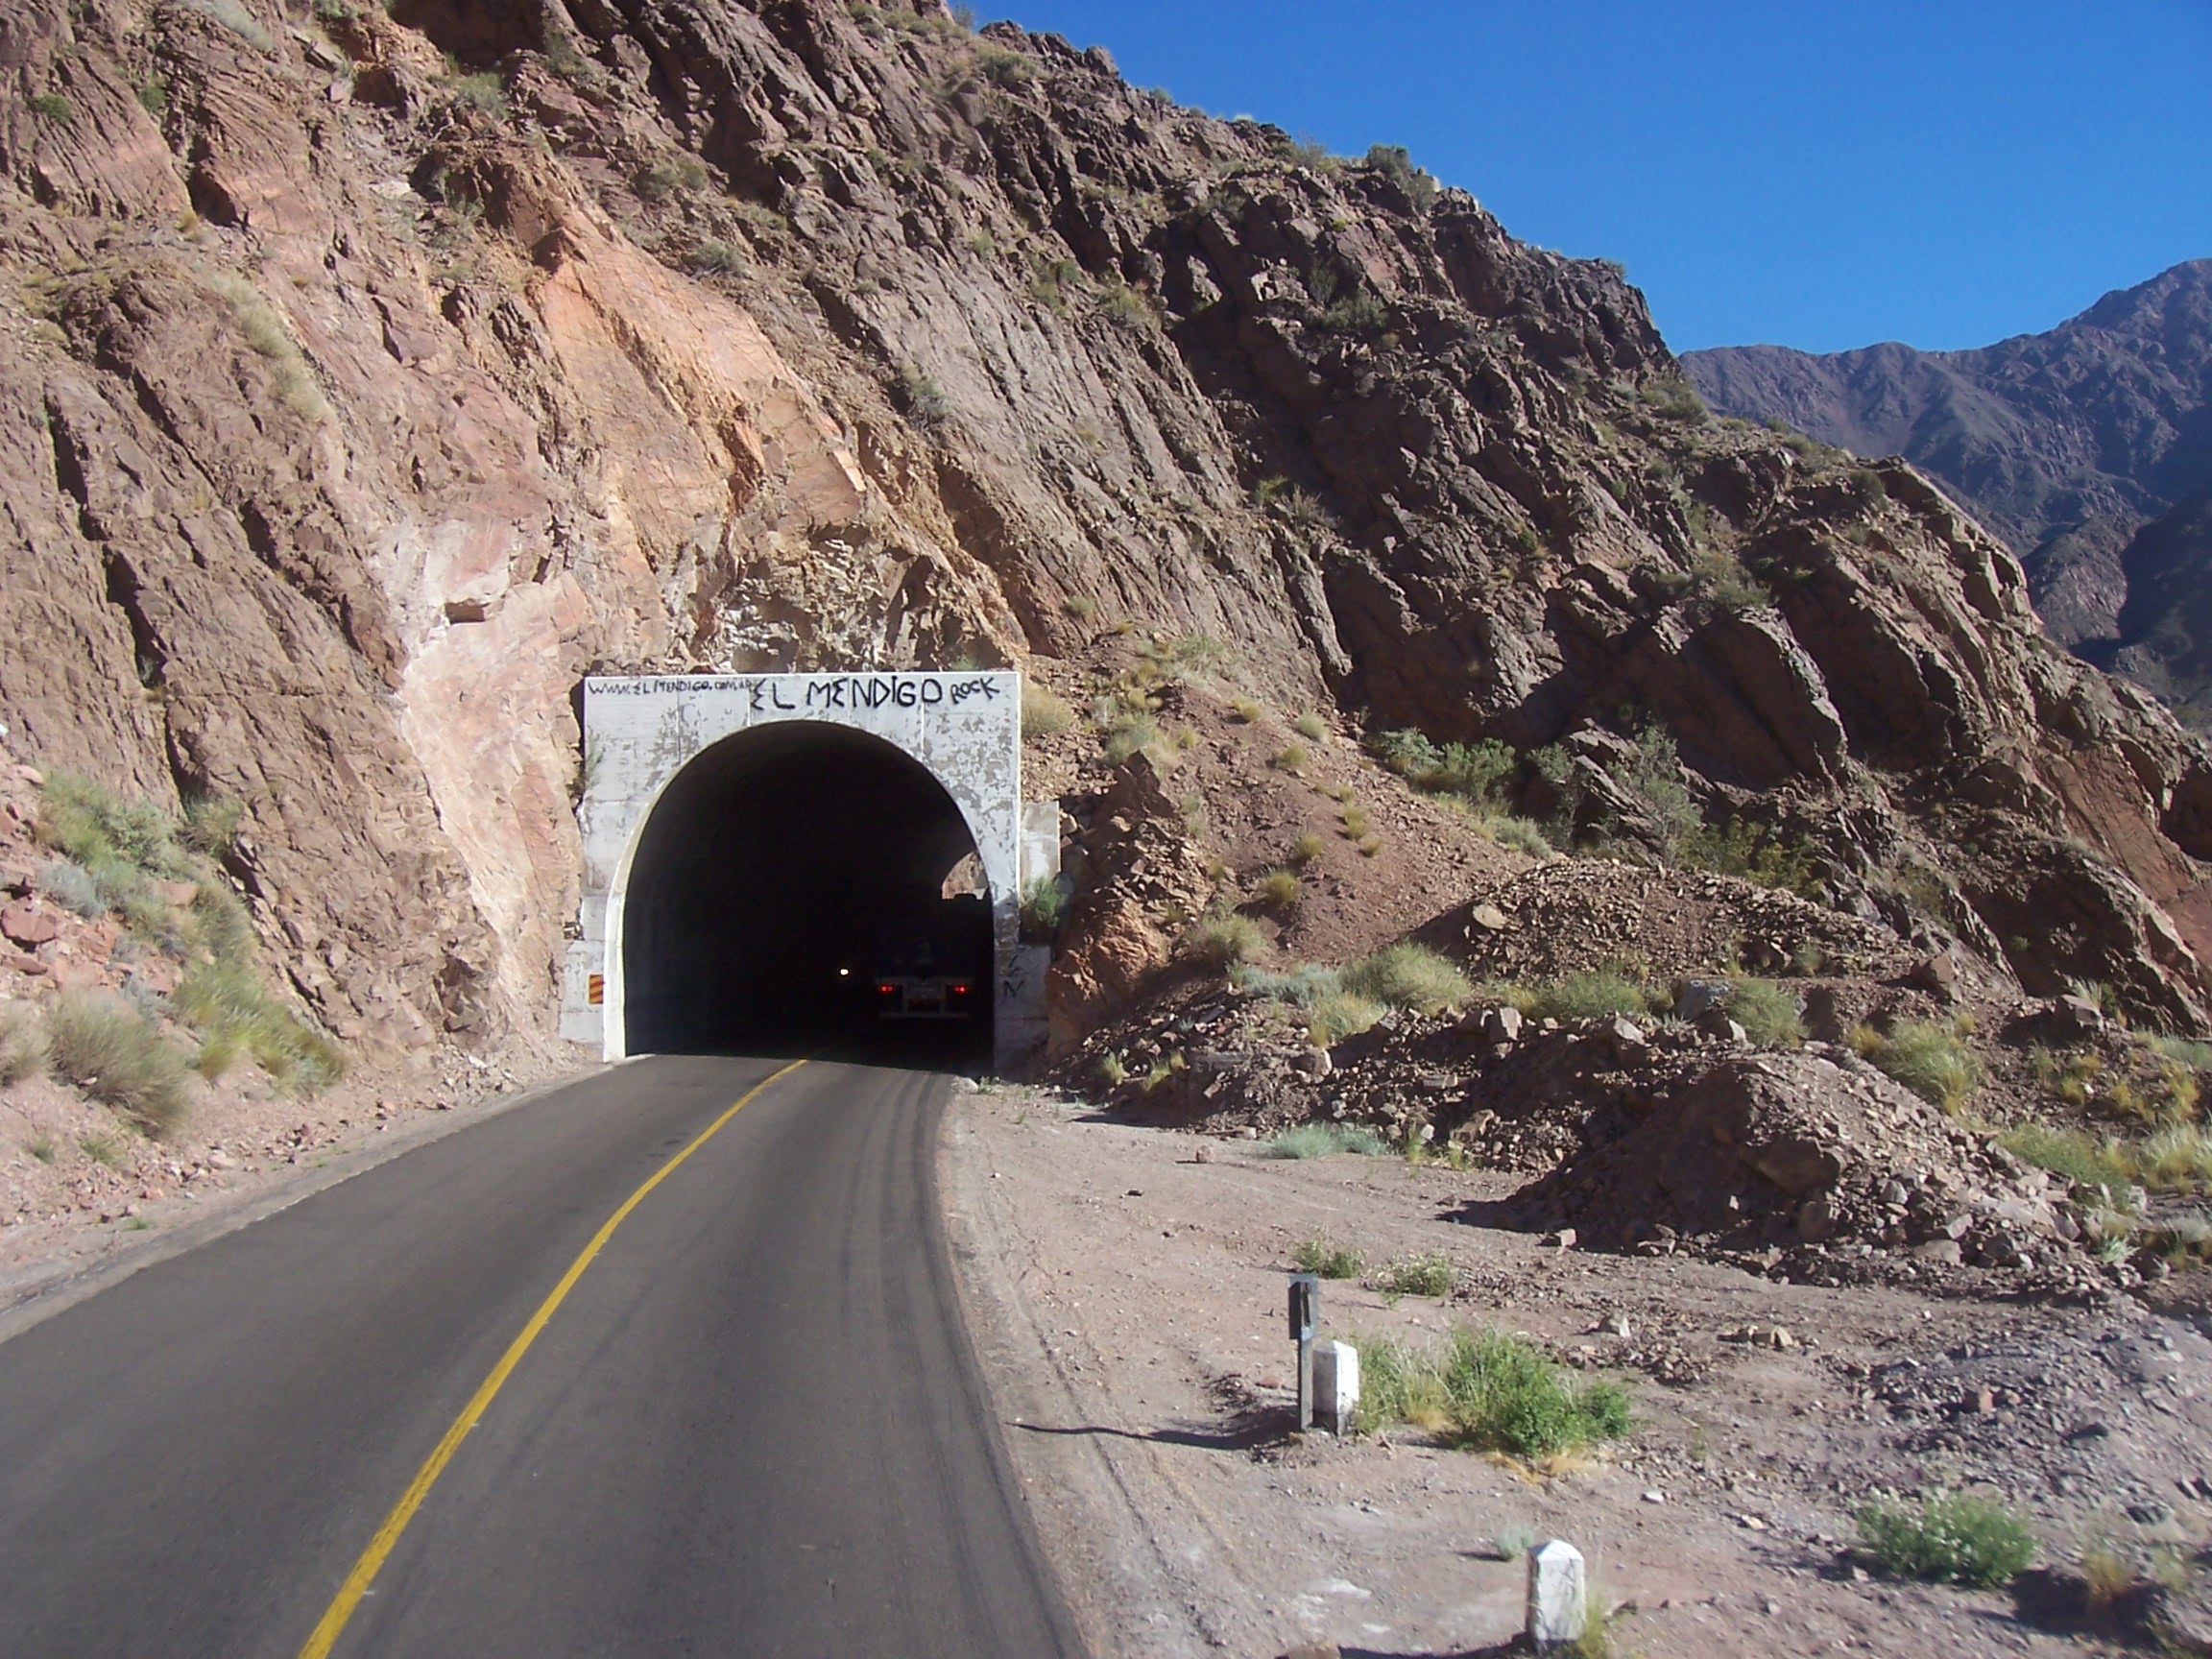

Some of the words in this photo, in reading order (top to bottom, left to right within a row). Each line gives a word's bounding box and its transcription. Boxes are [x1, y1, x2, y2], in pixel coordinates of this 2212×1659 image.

[750, 677, 796, 710] EL
[806, 675, 944, 709] MENDIGO
[950, 676, 1000, 706] ROCK
